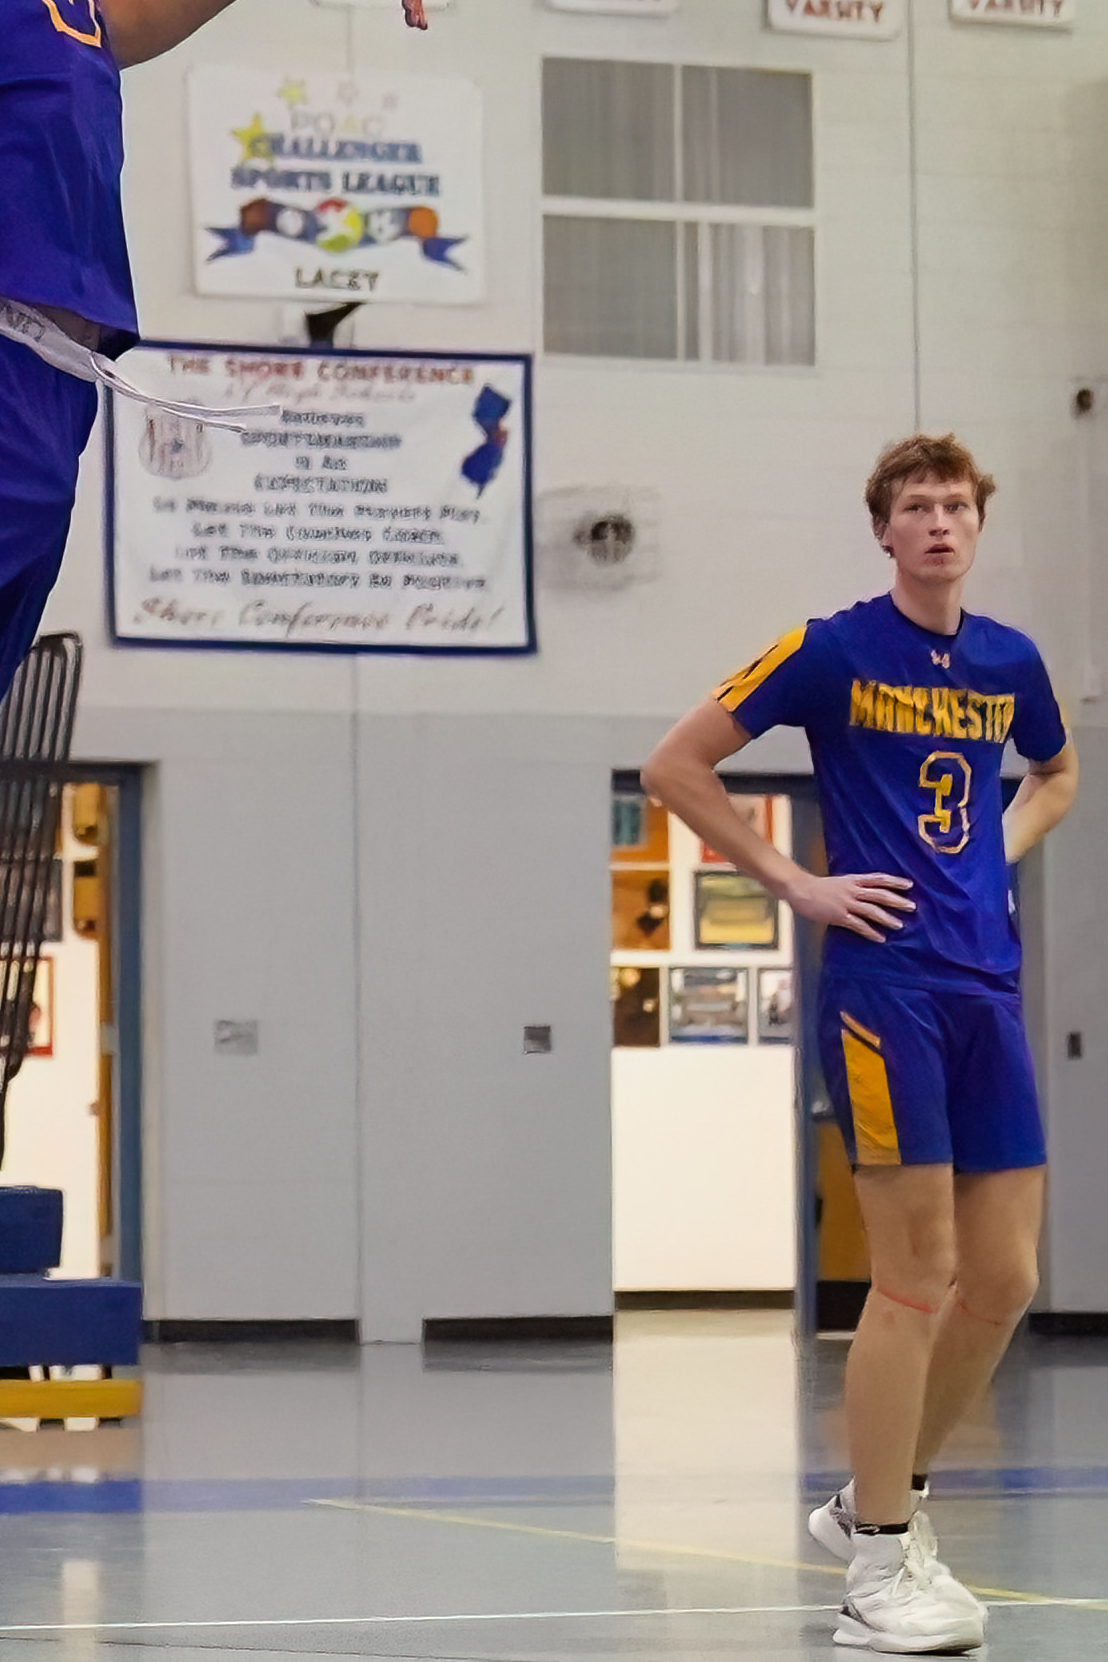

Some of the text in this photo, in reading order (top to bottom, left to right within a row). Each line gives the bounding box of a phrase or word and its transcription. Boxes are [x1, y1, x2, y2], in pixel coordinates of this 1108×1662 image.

[250, 135, 421, 162] CHALLENGER
[232, 169, 440, 195] SPORTS LEAGUE
[295, 269, 380, 291] LACEY
[169, 356, 474, 384] THE SHORE CONFERENCE
[918, 749, 972, 854] 3
